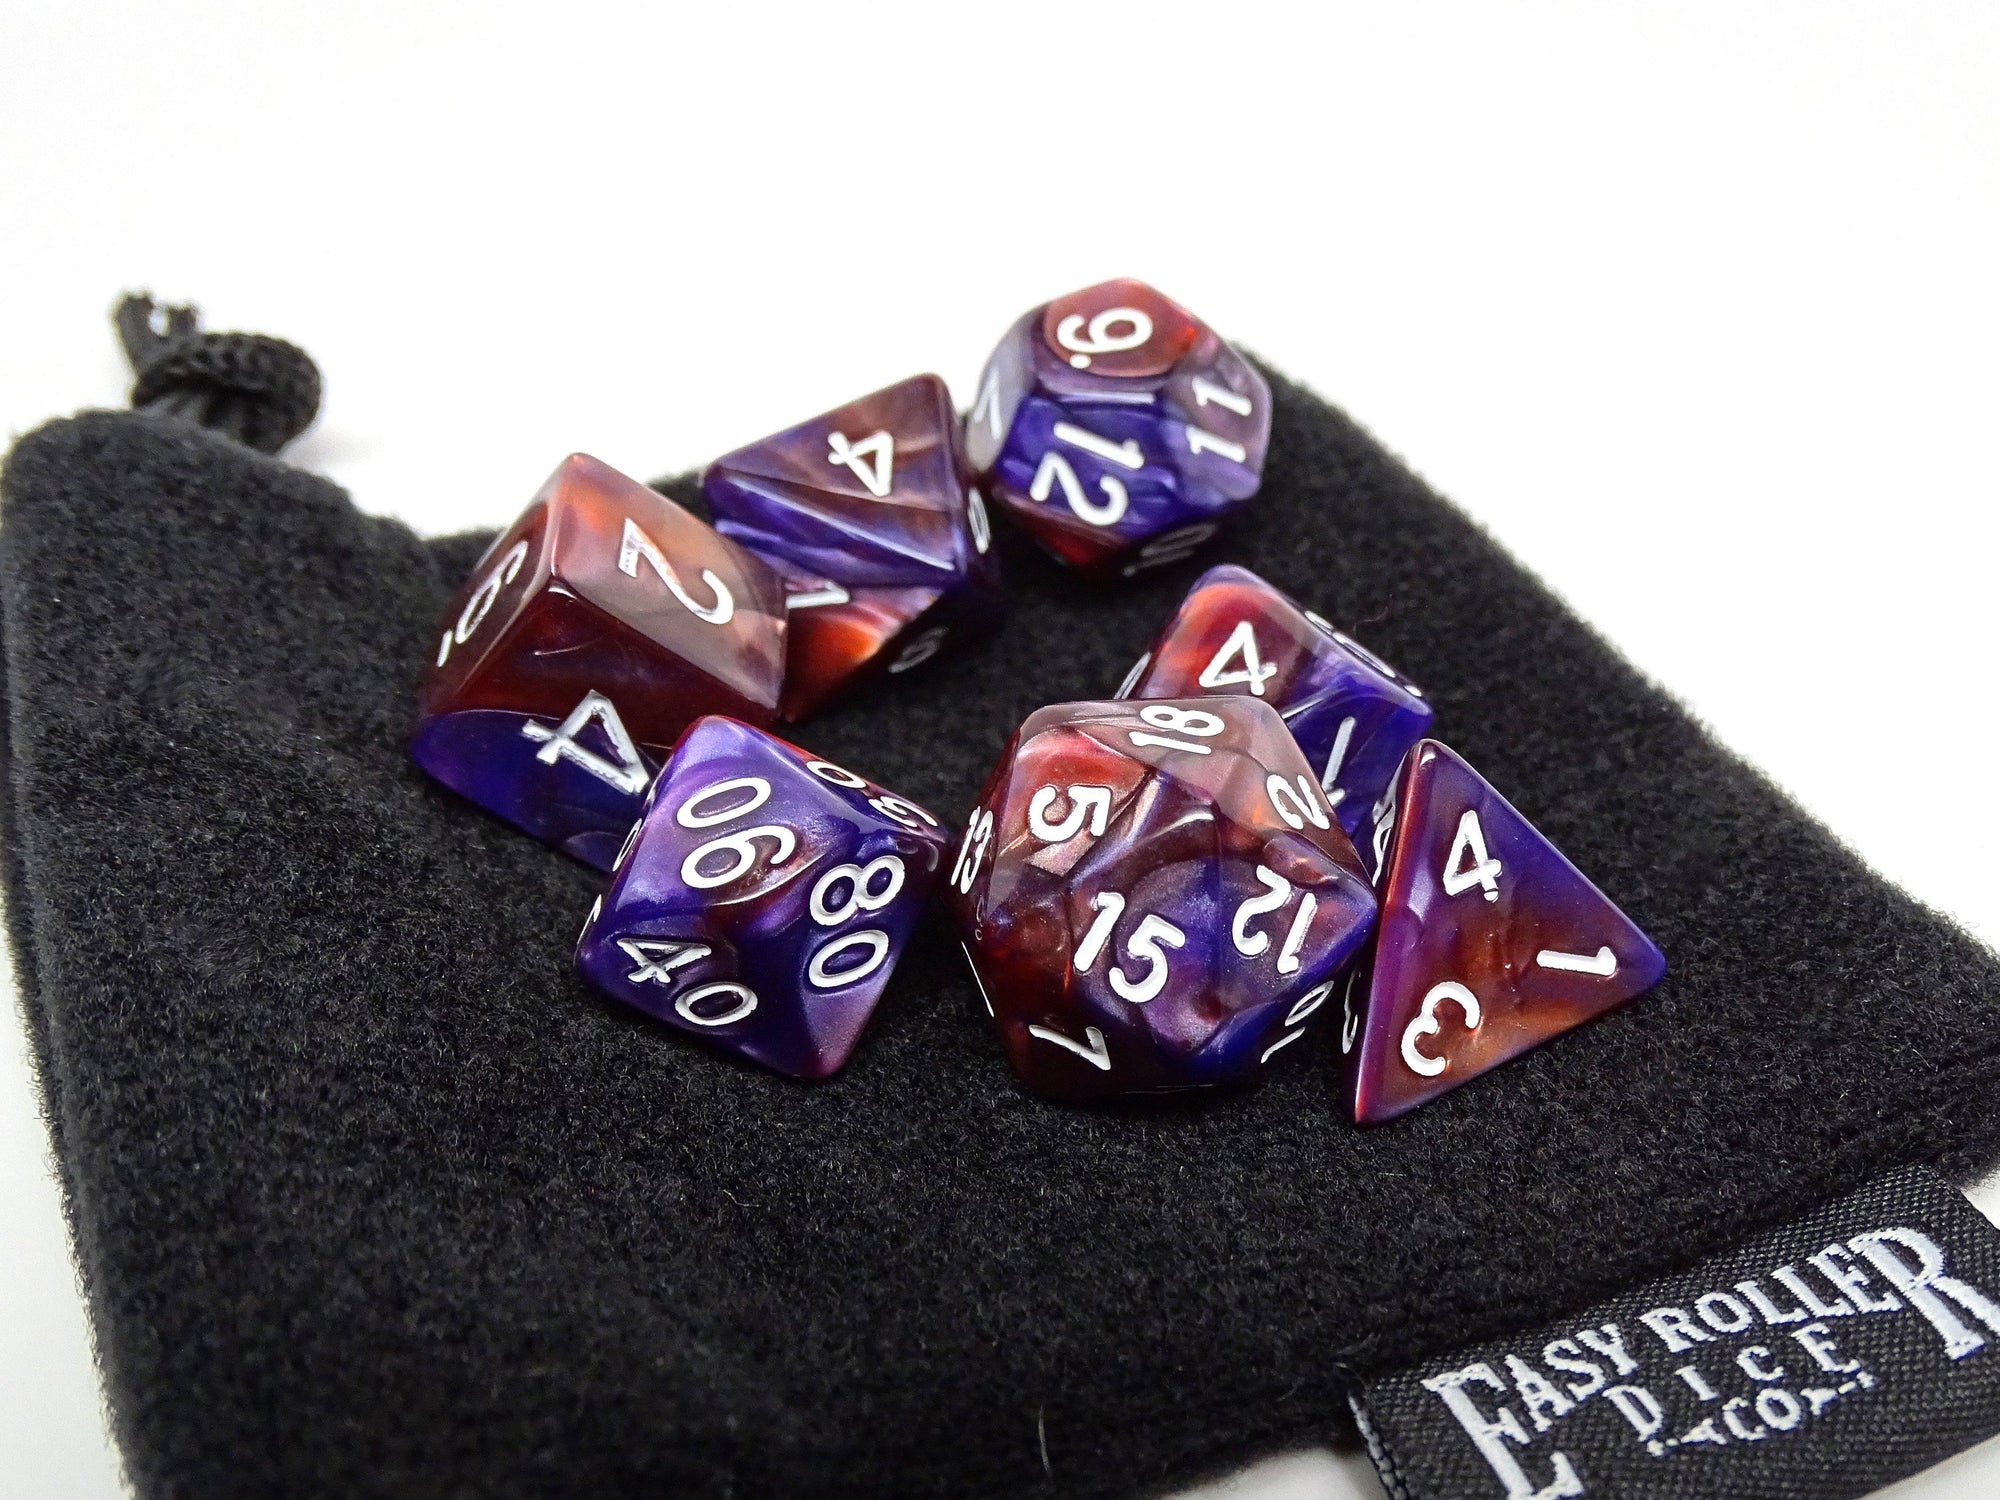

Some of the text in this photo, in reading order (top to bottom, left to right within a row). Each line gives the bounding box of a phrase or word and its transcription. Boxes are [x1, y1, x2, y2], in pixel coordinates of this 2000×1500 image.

[828, 430, 895, 497] 4
[1185, 376, 1253, 463] 11
[1029, 421, 1146, 527] 12
[619, 518, 735, 625] 2
[1199, 620, 1278, 696] 4
[522, 689, 652, 795] 4
[1128, 705, 1226, 755] 18
[676, 777, 796, 889] 90
[1028, 785, 1113, 842] 5
[1266, 773, 1331, 830] 2
[950, 805, 994, 895] 13
[1442, 810, 1502, 902] 4
[808, 855, 906, 989] 80
[1073, 891, 1186, 1004] 15
[1231, 864, 1318, 976] 12
[1536, 945, 1617, 977] 1
[616, 937, 758, 1027] 40
[1401, 980, 1481, 1077] 3
[1420, 1226, 2000, 1500] EASY ROLLER
[1602, 1322, 1862, 1443] DICE
